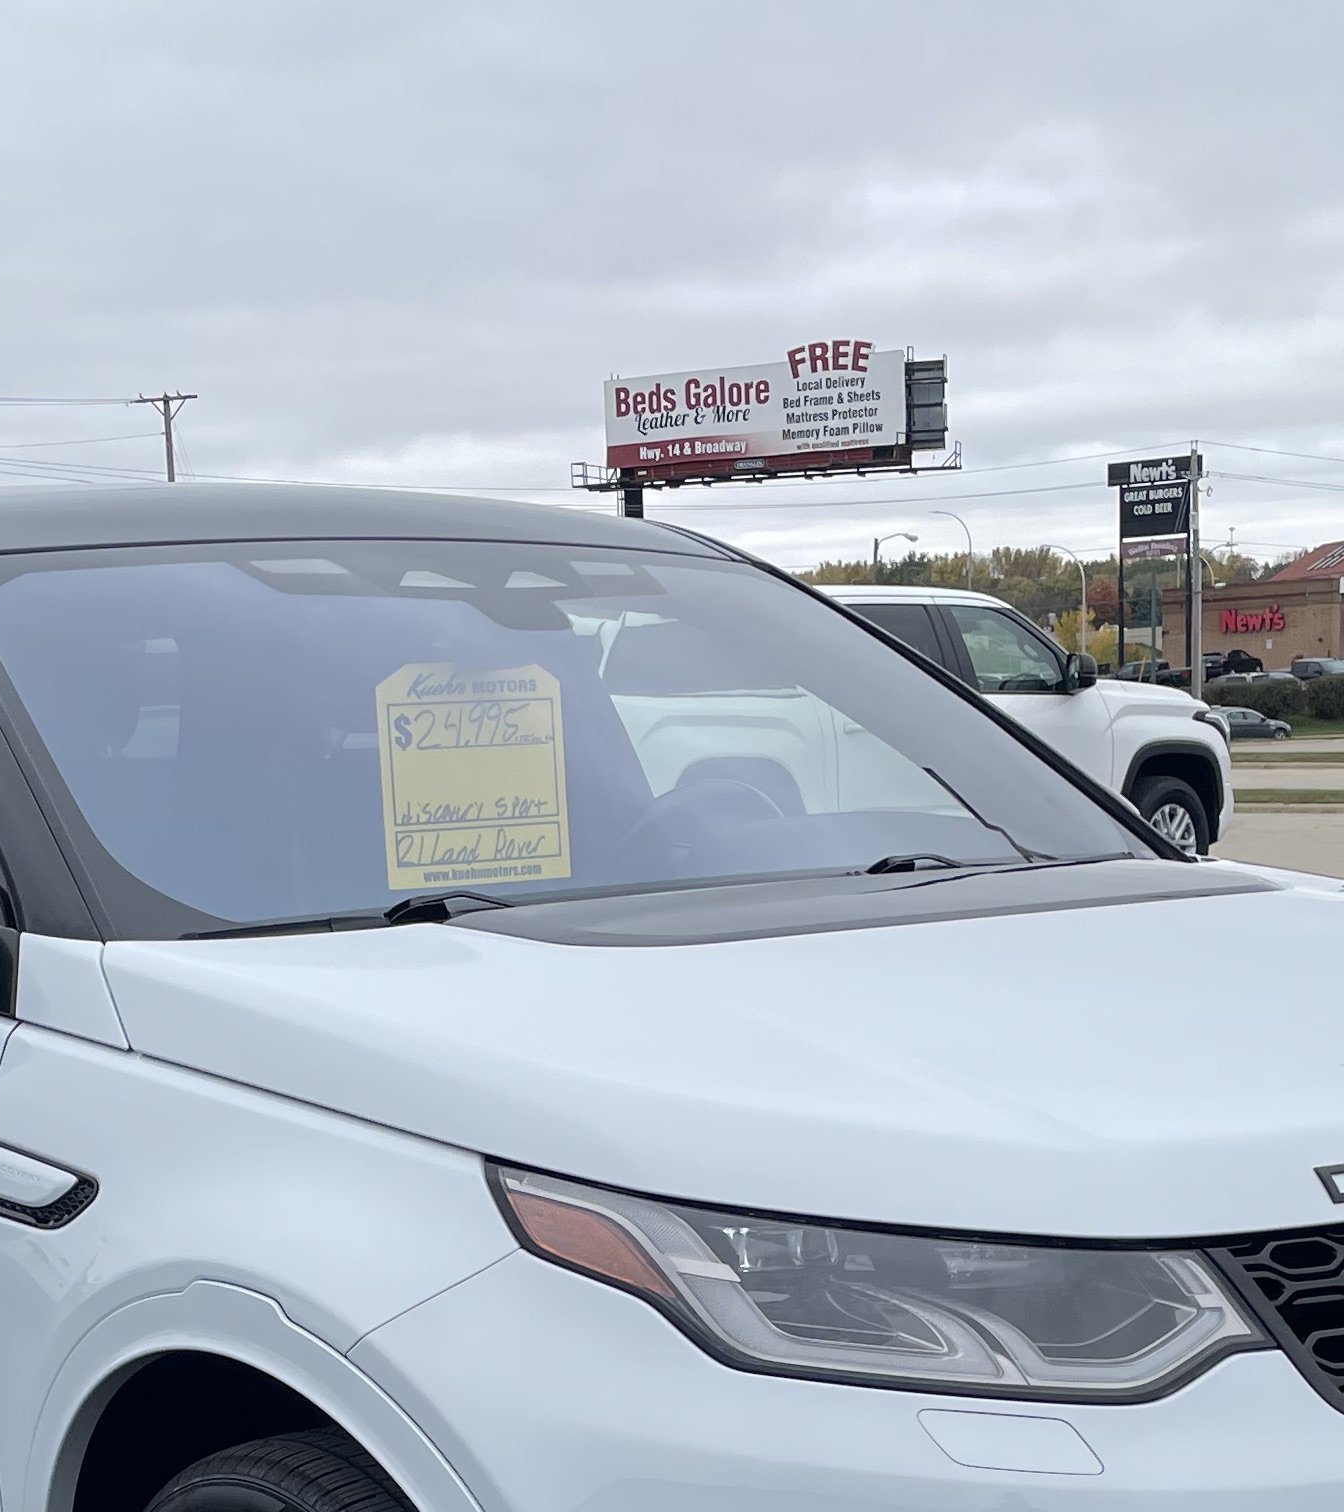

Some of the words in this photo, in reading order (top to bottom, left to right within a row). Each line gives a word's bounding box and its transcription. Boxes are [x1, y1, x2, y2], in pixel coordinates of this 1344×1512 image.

[787, 340, 872, 379] FREE
[796, 378, 823, 392] Local
[825, 377, 866, 389] Delivery
[615, 383, 677, 417] Beds
[684, 376, 770, 410] Galore
[783, 396, 801, 409] Bed
[803, 395, 834, 407] Frame
[837, 392, 844, 404] &
[847, 390, 881, 403] Sheets
[635, 411, 690, 436] Leather
[694, 406, 706, 425] &
[712, 405, 751, 424] More
[786, 412, 829, 424] Mattress
[832, 407, 878, 420] Protector
[782, 427, 821, 440] Memory
[823, 425, 850, 437] Foam
[852, 422, 884, 434] Pillow
[639, 446, 665, 462] Hwy.
[667, 444, 680, 458] 14
[683, 442, 692, 455] &
[695, 440, 748, 454] Broadway
[1129, 459, 1177, 483] Newt's
[1124, 490, 1147, 502] GREAT
[1149, 487, 1183, 500] BURGERS
[1133, 504, 1153, 515] COLD
[1155, 502, 1172, 514] BEER
[1219, 602, 1285, 635] Newt's
[407, 673, 465, 700] Kuehn
[472, 679, 537, 694] MOTORS
[398, 833, 425, 867] 21
[430, 832, 482, 866] Land
[494, 827, 545, 860] Rover
[423, 864, 543, 883] www.kuehnmotors.com
